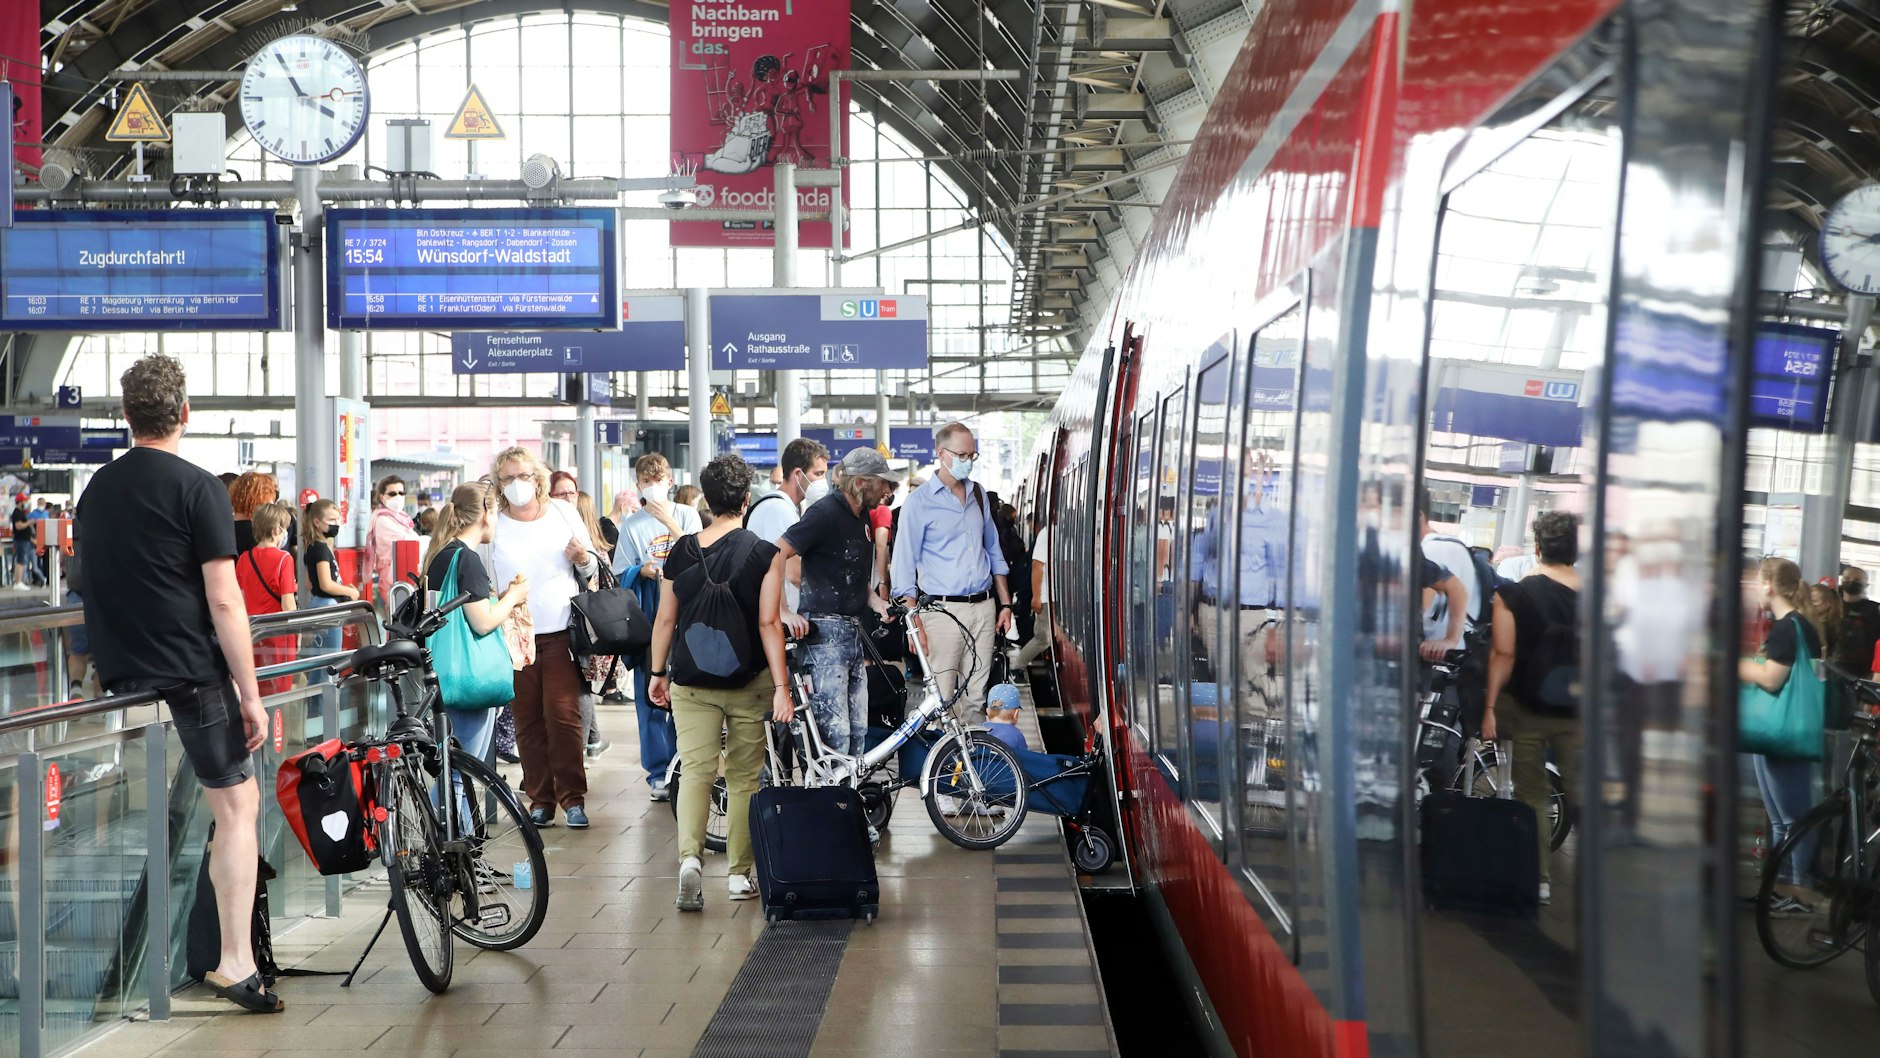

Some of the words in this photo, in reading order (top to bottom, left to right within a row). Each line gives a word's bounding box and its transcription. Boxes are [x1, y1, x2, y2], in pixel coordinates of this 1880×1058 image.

[692, 5, 779, 21] Nachbarn
[692, 22, 762, 42] bringen
[692, 39, 729, 54] das.
[720, 186, 829, 211] foodpnda
[416, 229, 428, 237] Bln
[430, 229, 464, 237] Ostkreuz
[345, 239, 353, 247] RE
[416, 239, 454, 247] Dahlewitz
[462, 239, 498, 248] Rangsdorf
[79, 250, 185, 268] Zugdurchfahrt!
[345, 249, 384, 264] 15:54
[417, 249, 571, 264] Wünsdorf-Waldstadt
[28, 297, 47, 305] 16:03
[80, 297, 89, 305] RE
[102, 297, 142, 306] Magdeburg
[144, 297, 185, 305] Herrenkrug
[203, 296, 225, 304] Berlin
[226, 296, 239, 304] Hbf
[439, 295, 503, 303] Eisenhüttenstadt
[509, 295, 519, 303] via
[521, 295, 573, 303] Fürstenwalde
[28, 306, 47, 314] 16:07
[80, 306, 89, 314] RE
[92, 306, 96, 314] 7
[102, 306, 129, 314] Dessau
[131, 306, 144, 314] Hbf
[150, 306, 161, 314] via
[163, 306, 184, 314] Berlin
[186, 306, 199, 314] Hbf
[418, 304, 427, 312] RE
[429, 304, 434, 312] 1
[439, 304, 496, 313] Frankfurt(Oder)
[502, 304, 513, 312] via
[515, 304, 566, 312] Fürstenwalde
[842, 301, 856, 317] S
[863, 301, 874, 317] U
[487, 335, 542, 345] Fernsehturm
[748, 332, 786, 343] Ausgang
[488, 347, 553, 358] Alexanderplatz
[747, 344, 810, 354] Rathausstraße
[67, 386, 80, 405] 3
